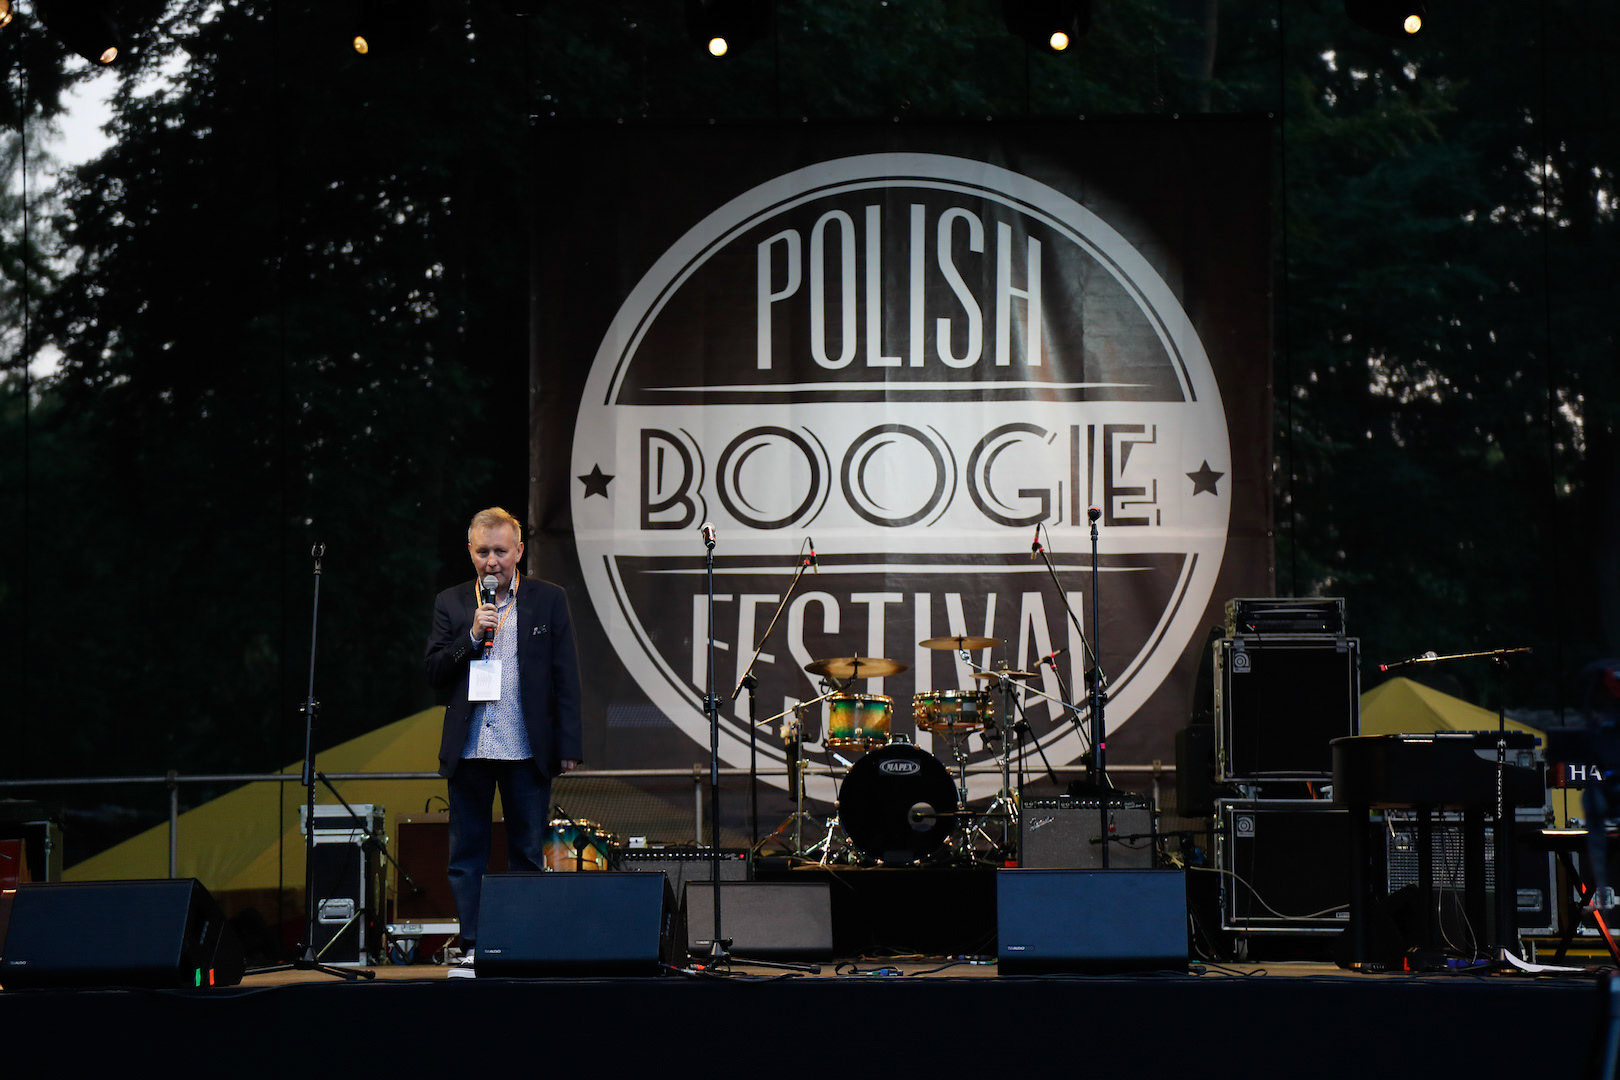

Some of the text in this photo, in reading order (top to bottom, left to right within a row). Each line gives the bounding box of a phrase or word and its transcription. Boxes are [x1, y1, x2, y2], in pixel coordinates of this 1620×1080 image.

[757, 203, 1042, 370] POLISH
[640, 422, 1161, 530] BOOGIE
[883, 761, 915, 774] MAPEX
